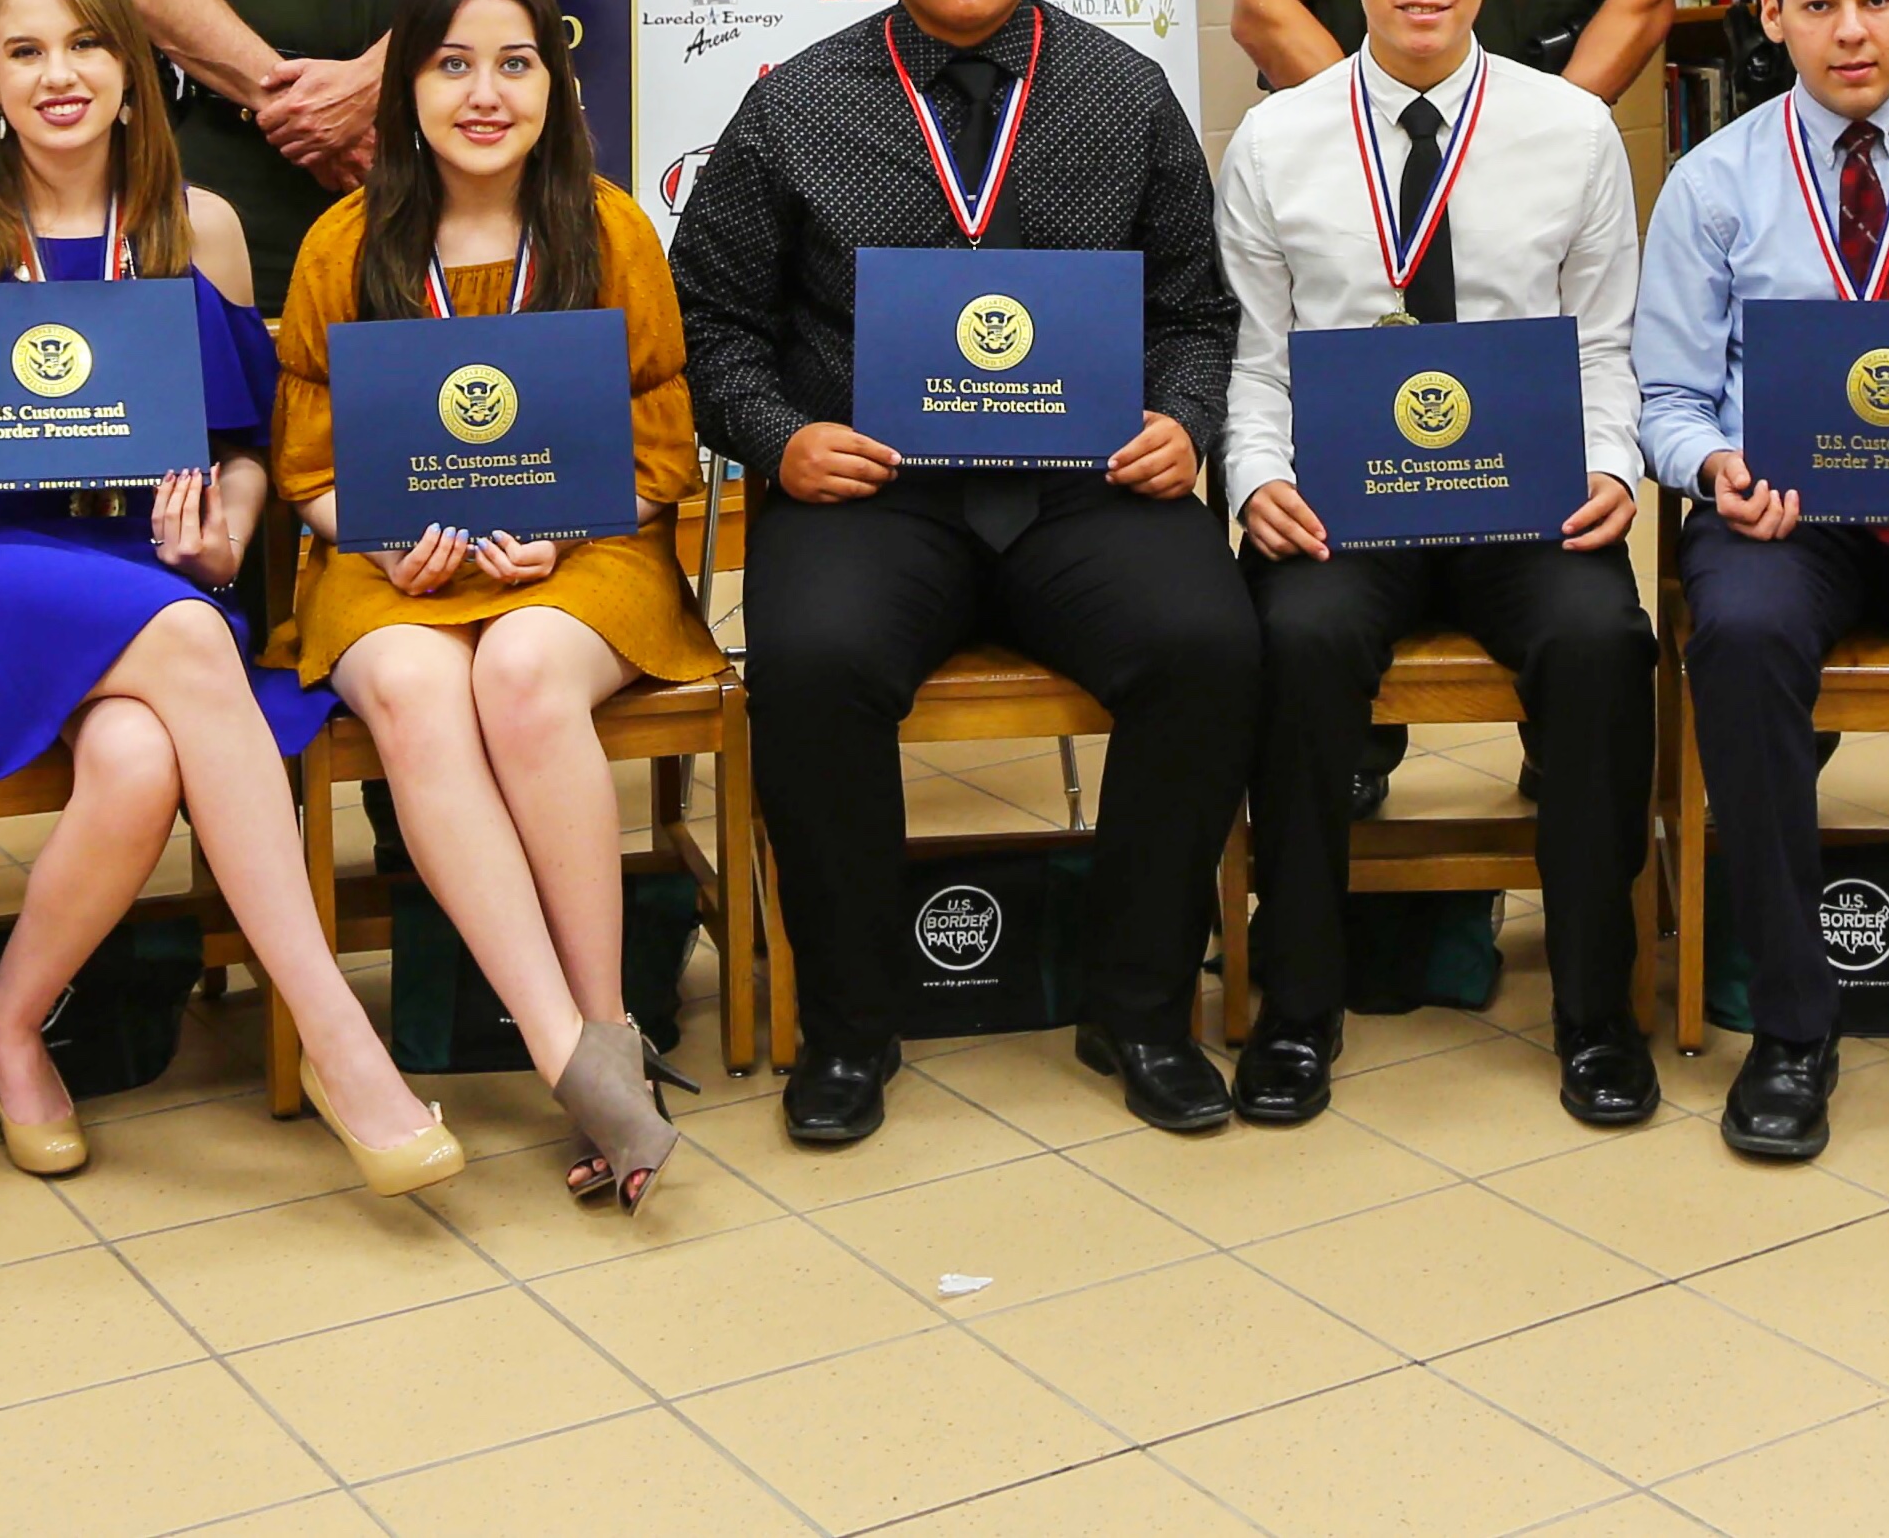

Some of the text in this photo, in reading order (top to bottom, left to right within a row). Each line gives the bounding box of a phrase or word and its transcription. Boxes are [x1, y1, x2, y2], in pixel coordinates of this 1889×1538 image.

[643, 11, 783, 27] Laredo Energy
[683, 27, 741, 63] Arena
[926, 379, 1062, 395] U.S. Customs and
[19, 404, 91, 420] Customs
[94, 402, 125, 418] and
[922, 397, 1066, 414] Border Protection
[44, 422, 130, 437] Protection
[1816, 435, 1847, 450] U.S.
[410, 449, 551, 472] U.S. Customs and
[1367, 454, 1505, 475] U.S. Customs and
[1812, 454, 1869, 469] Border
[39, 481, 82, 489] SERVICE
[104, 478, 162, 487] INTEGRITY
[408, 469, 557, 491] Border Protection
[1365, 476, 1509, 495] Border Protection
[1341, 533, 1540, 549] VIGILANCE SERVICE INTEGRITY
[947, 899, 973, 911] U.S.
[1839, 894, 1867, 909] U.S.
[926, 915, 989, 929] BORDER
[1821, 914, 1885, 928] BORDER
[928, 931, 988, 946] PATROL
